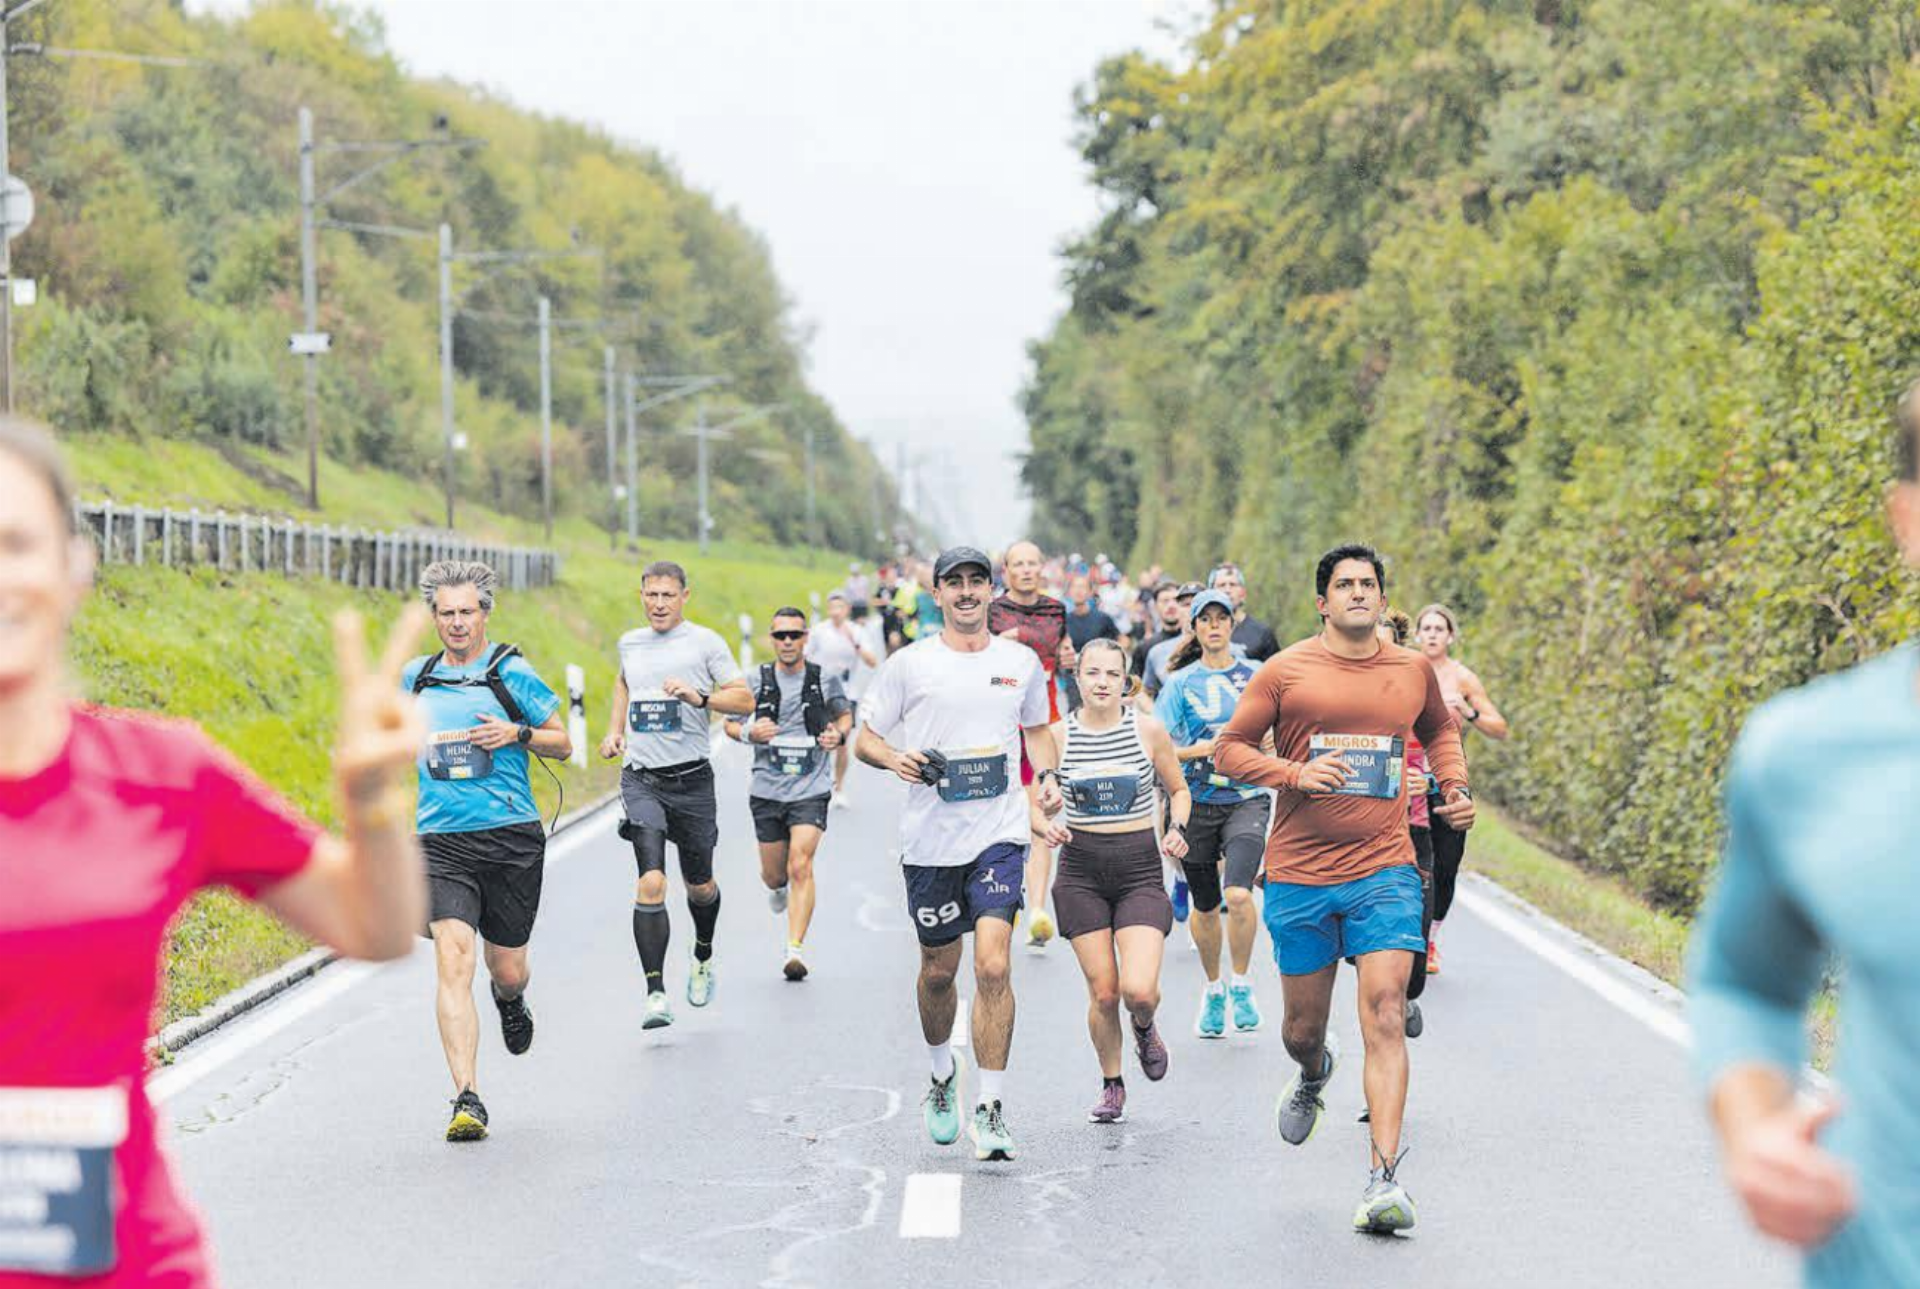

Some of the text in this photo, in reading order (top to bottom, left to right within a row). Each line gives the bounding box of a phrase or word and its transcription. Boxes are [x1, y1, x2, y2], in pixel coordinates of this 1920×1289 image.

[1323, 736, 1379, 749] MIGROS
[446, 743, 472, 756] HEINZ
[958, 762, 990, 775] JULIAN
[1097, 781, 1114, 791] MIA
[986, 881, 1010, 895] AIR
[916, 900, 961, 927] 69
